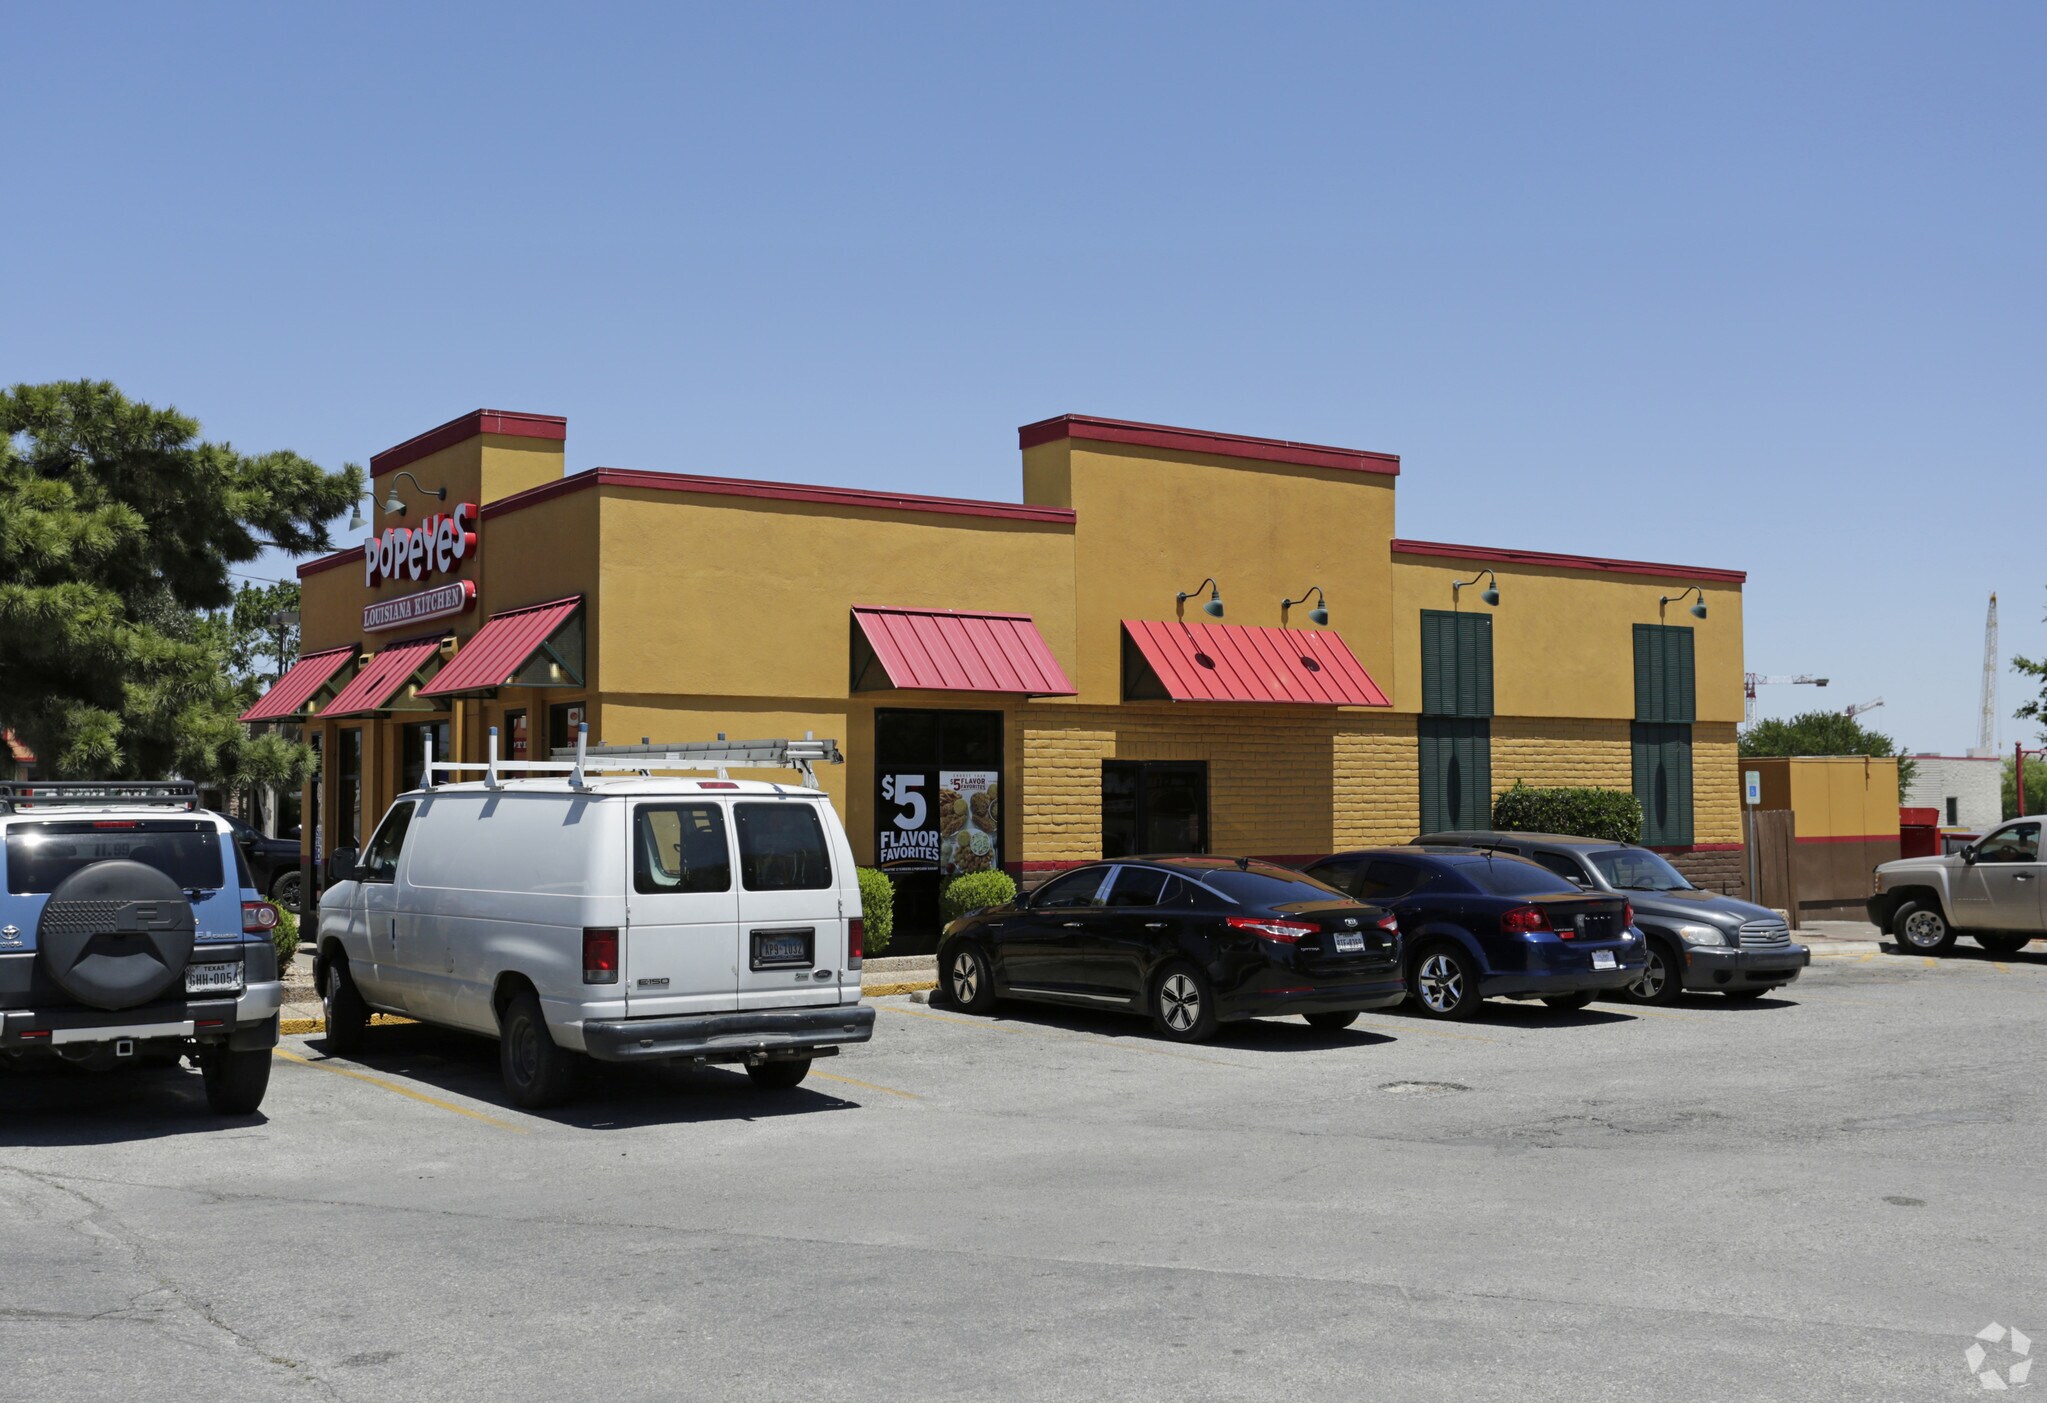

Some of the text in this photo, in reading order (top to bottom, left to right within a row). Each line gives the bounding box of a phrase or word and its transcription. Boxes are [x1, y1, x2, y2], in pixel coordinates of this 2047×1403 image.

[363, 587, 460, 627] LOUISIANA KITCHEN
[881, 774, 927, 831] $5
[880, 830, 939, 849] FLAVOR
[880, 846, 940, 863] FAVORITES
[203, 964, 225, 972] TEXAS
